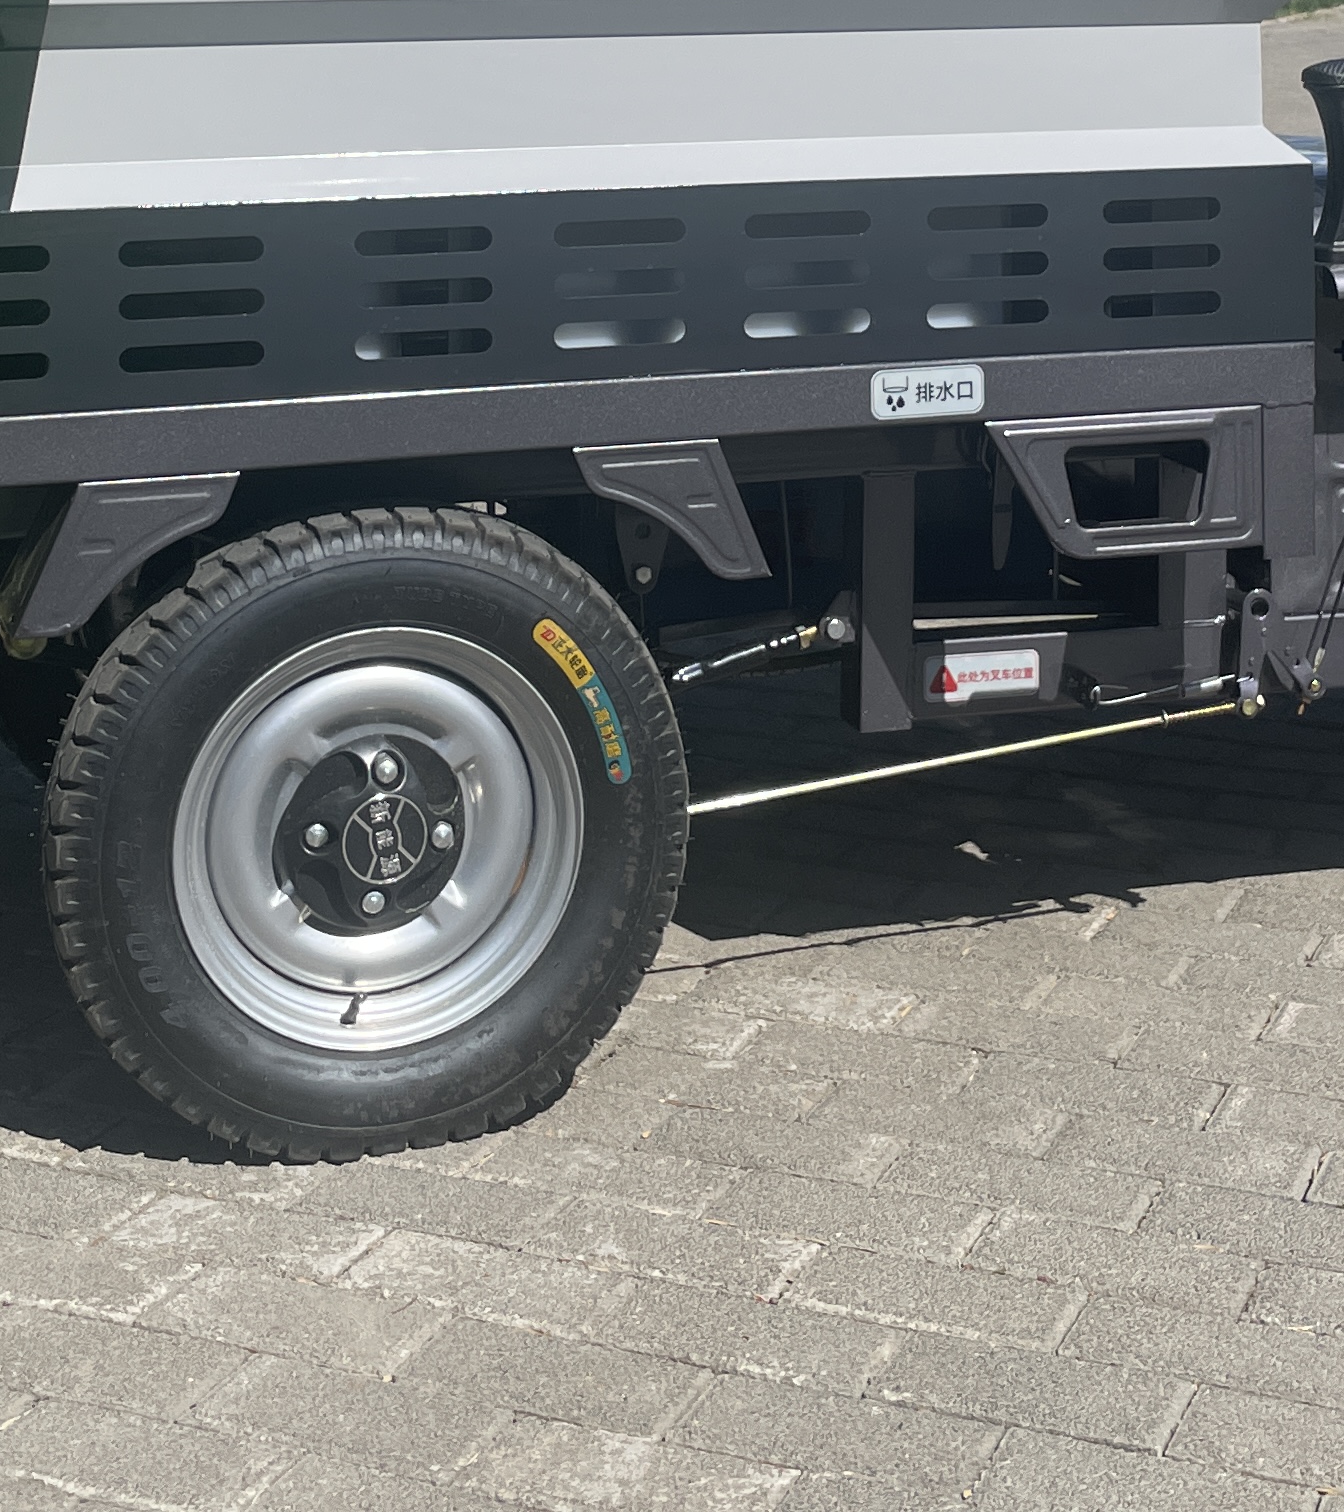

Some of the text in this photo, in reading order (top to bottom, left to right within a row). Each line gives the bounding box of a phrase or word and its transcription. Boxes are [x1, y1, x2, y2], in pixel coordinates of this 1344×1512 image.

[916, 381, 973, 404] 排水口
[957, 667, 1033, 683] 此处为叉车位置
